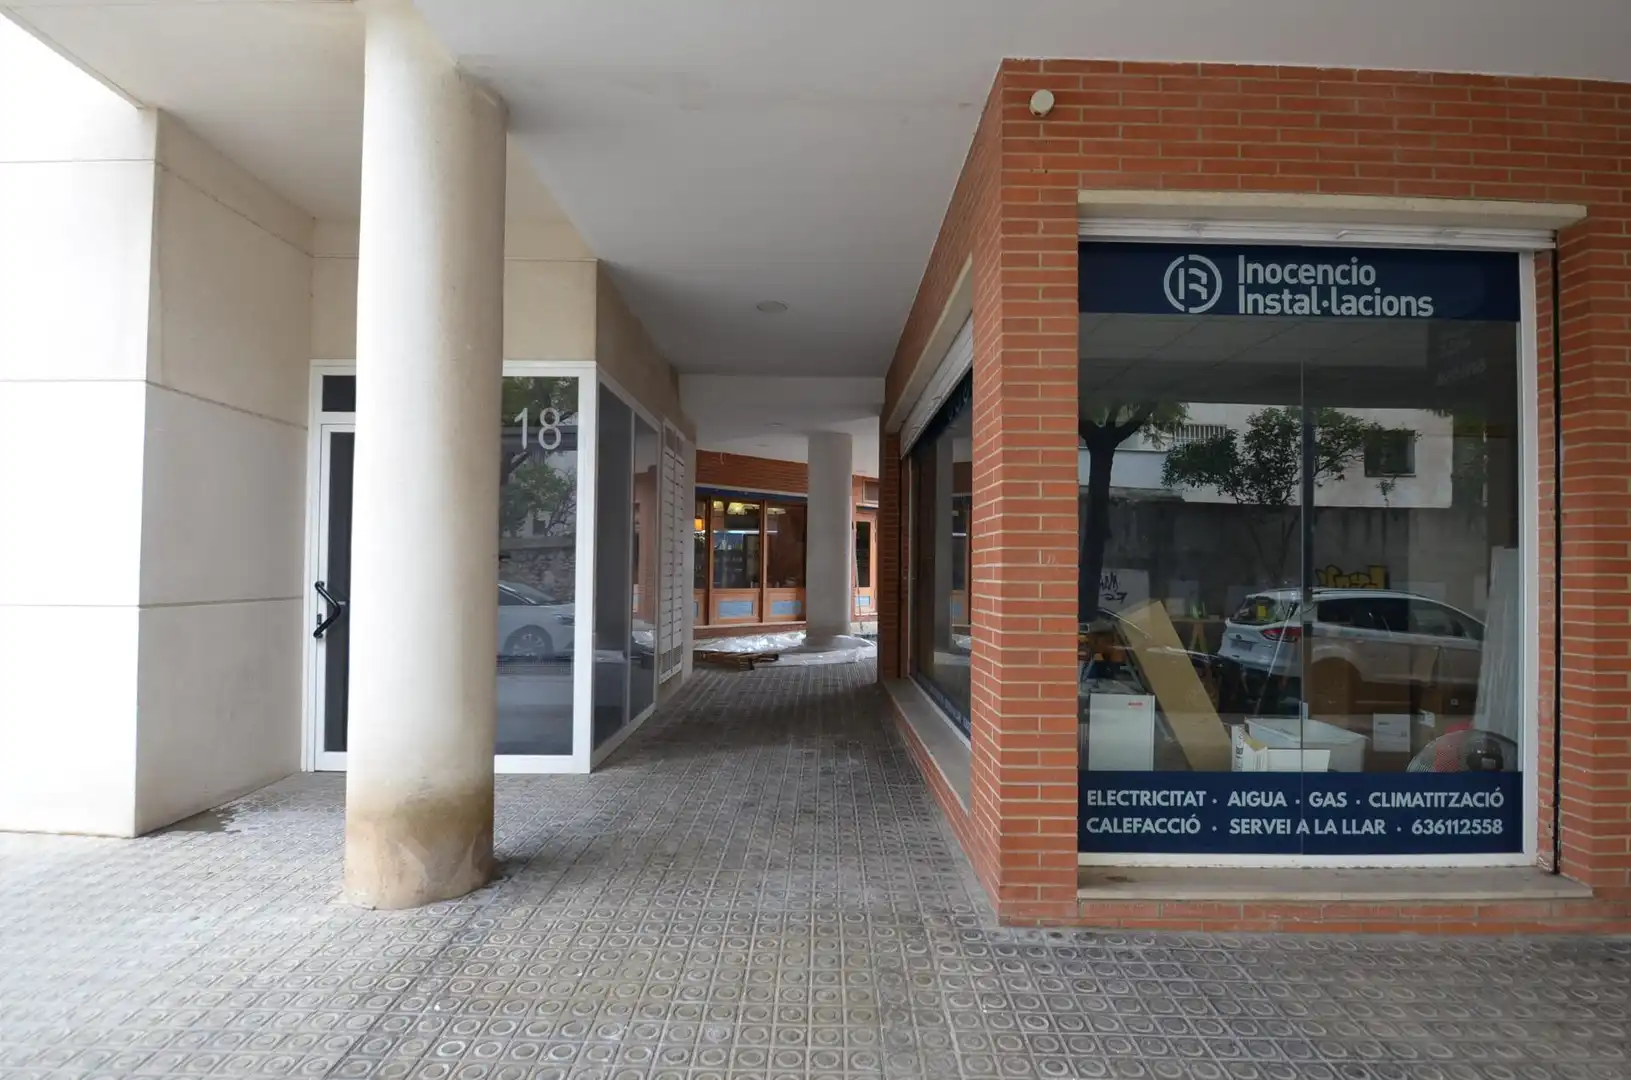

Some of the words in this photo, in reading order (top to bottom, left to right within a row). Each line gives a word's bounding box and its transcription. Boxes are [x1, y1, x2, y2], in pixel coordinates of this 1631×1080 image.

[1238, 255, 1376, 286] Inocencio
[1238, 284, 1434, 317] Instal·lacions
[514, 407, 563, 450] 18
[1087, 789, 1207, 807] ELECTRICITAT
[1227, 790, 1288, 808] AIGUA
[1309, 791, 1348, 808] GAS
[1369, 786, 1505, 808] CLIMATITZACIÓ
[1086, 813, 1201, 835] CALEFACCIÓ
[1229, 817, 1291, 835] SERVEI
[1296, 818, 1311, 835] A
[1314, 818, 1338, 835] LA
[1342, 818, 1387, 835] LLAR
[1412, 818, 1503, 835] 636112558
